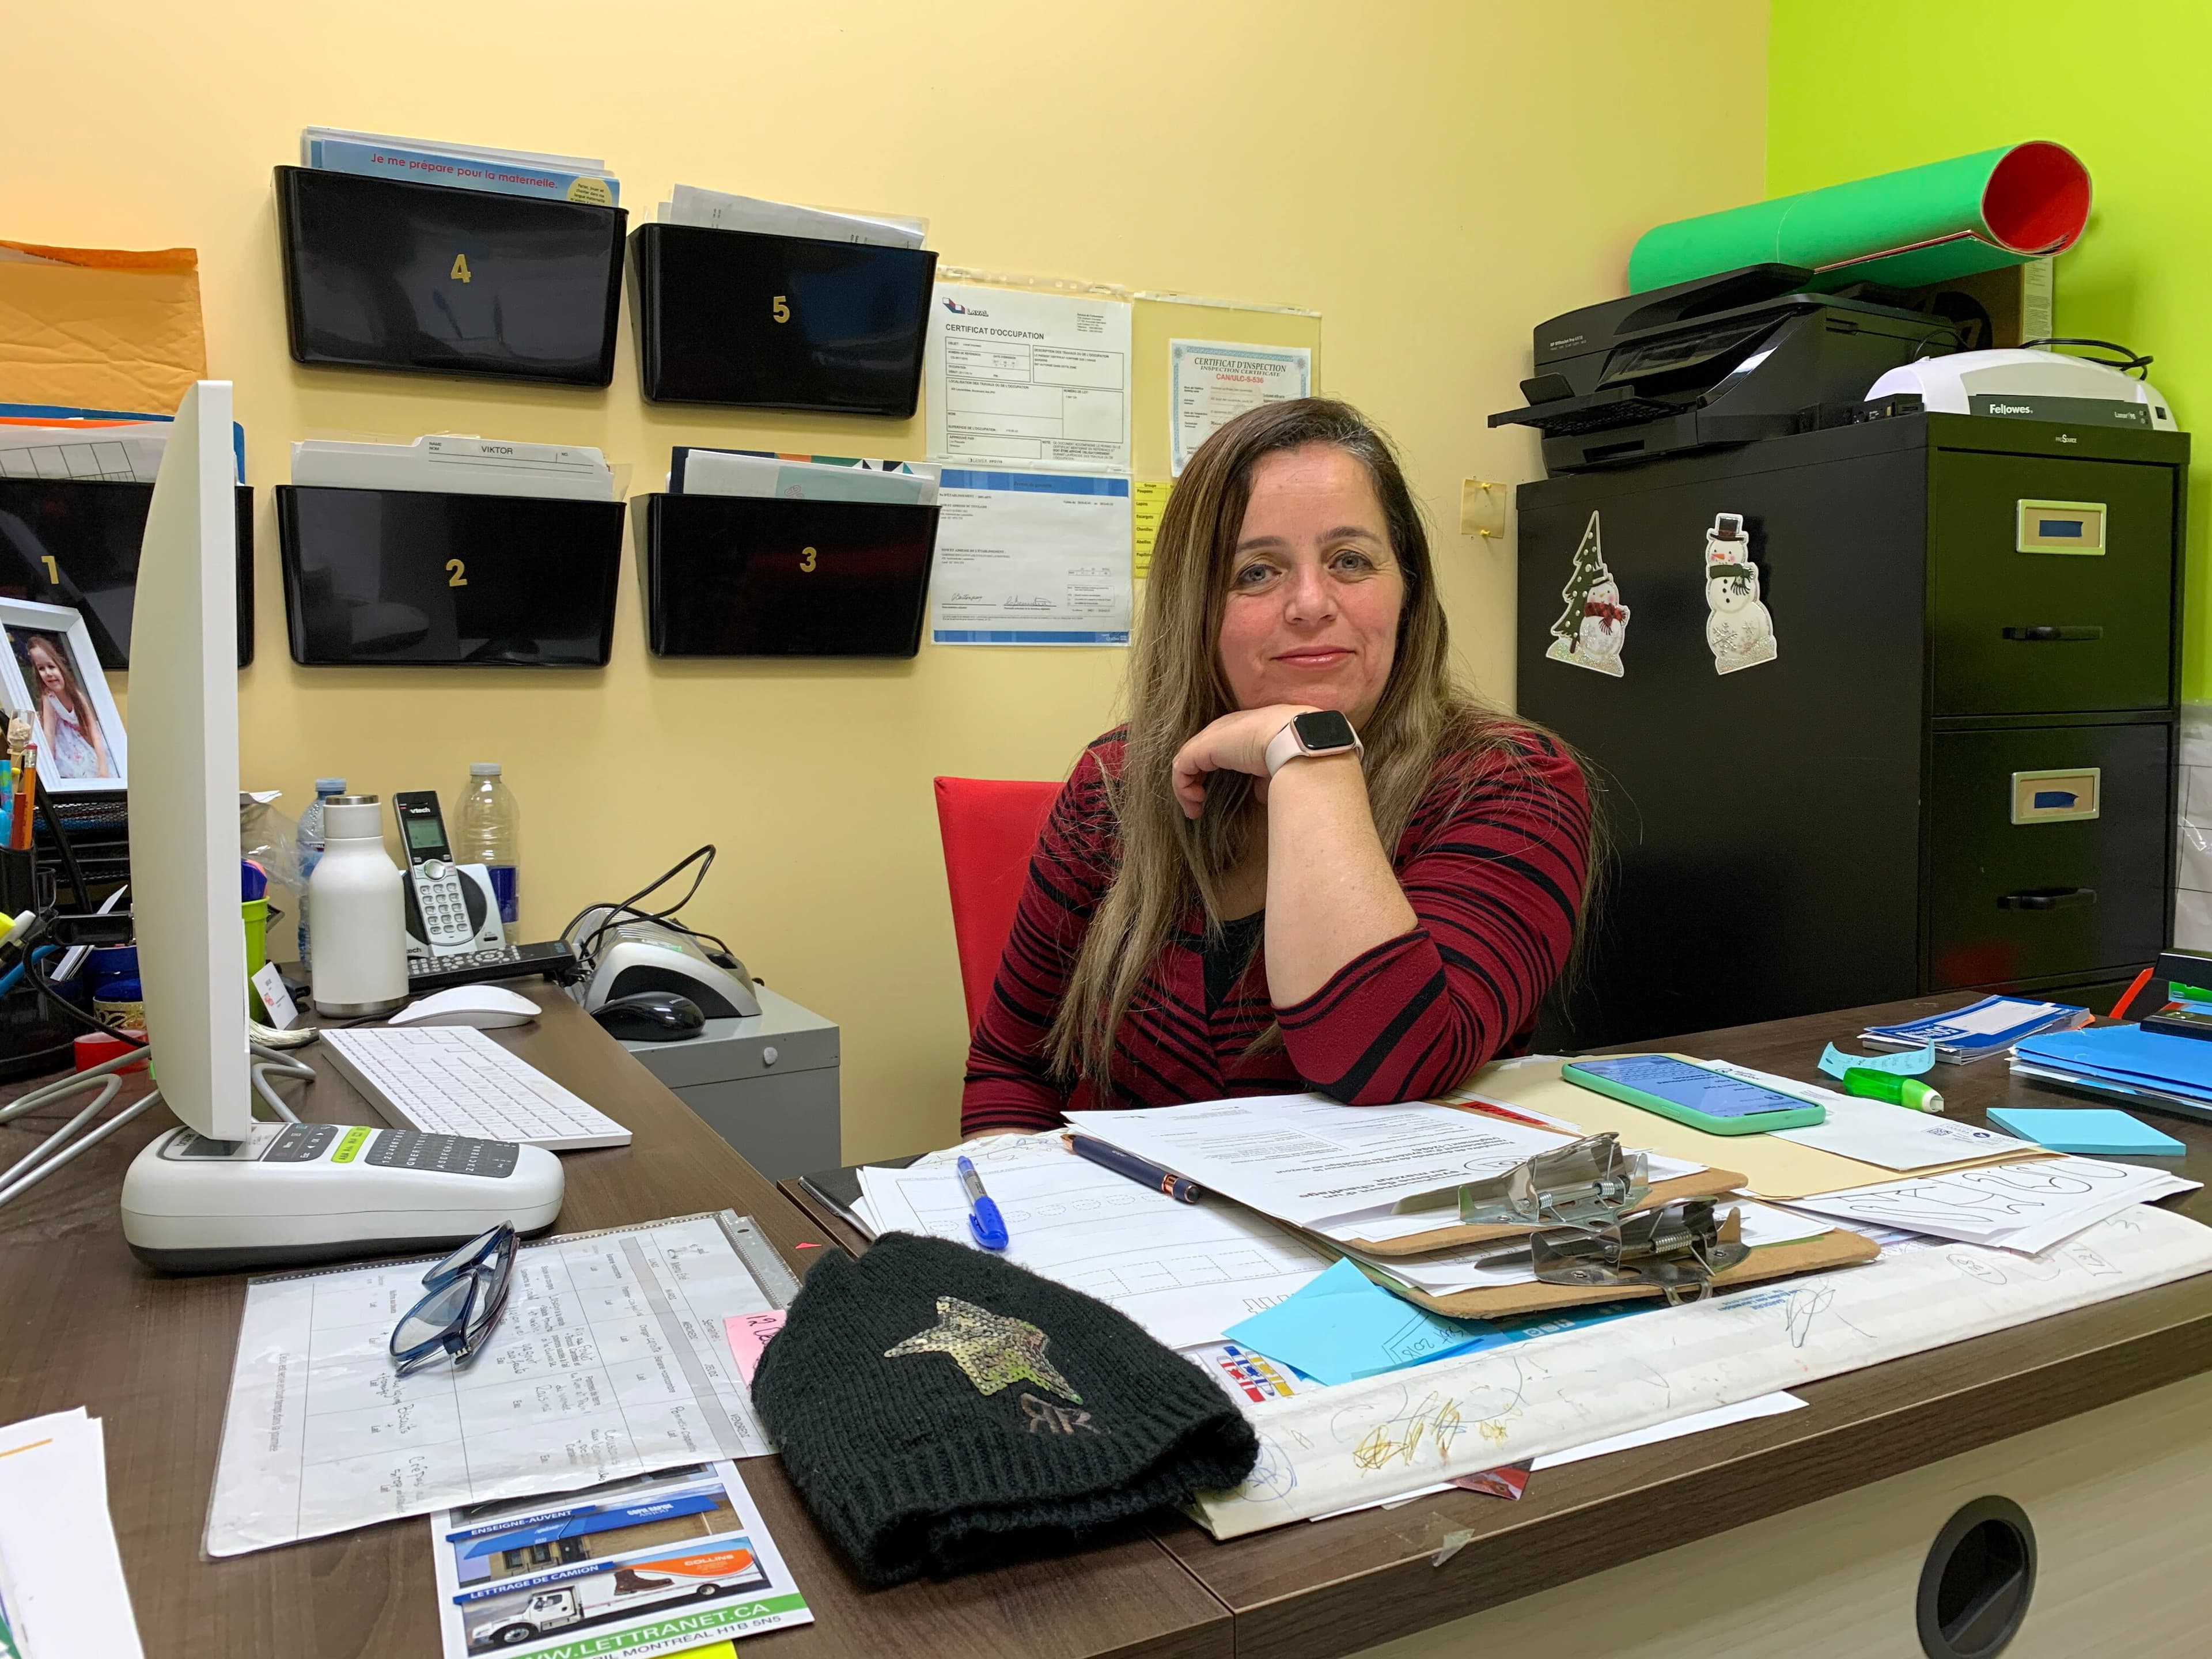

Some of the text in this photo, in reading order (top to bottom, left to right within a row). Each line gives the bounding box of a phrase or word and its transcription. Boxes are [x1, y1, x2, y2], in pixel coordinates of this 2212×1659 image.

[371, 153, 557, 188] Je me prépare pour la maternelle.
[450, 253, 471, 283] 4
[773, 296, 790, 323] 5
[967, 308, 989, 317] LAVAL
[945, 324, 1044, 340] CERTIFICAT D'OCCUPATION
[1195, 357, 1286, 372] CERTIFICAT D'INSPECTION
[1990, 404, 2030, 415] Fellowes
[482, 446, 513, 454] VIKTOR
[41, 555, 59, 584] 1
[446, 559, 468, 587] 2
[800, 547, 817, 573] 3
[730, 1414, 749, 1438] VENDREDI
[471, 1510, 572, 1536] ENSEIGNE-AUVENT
[684, 1555, 734, 1566] COLLINS
[469, 1565, 599, 1600] LETTRAGE DE CAMION
[623, 1615, 782, 1658] MONTRÉAL H1B 5N5
